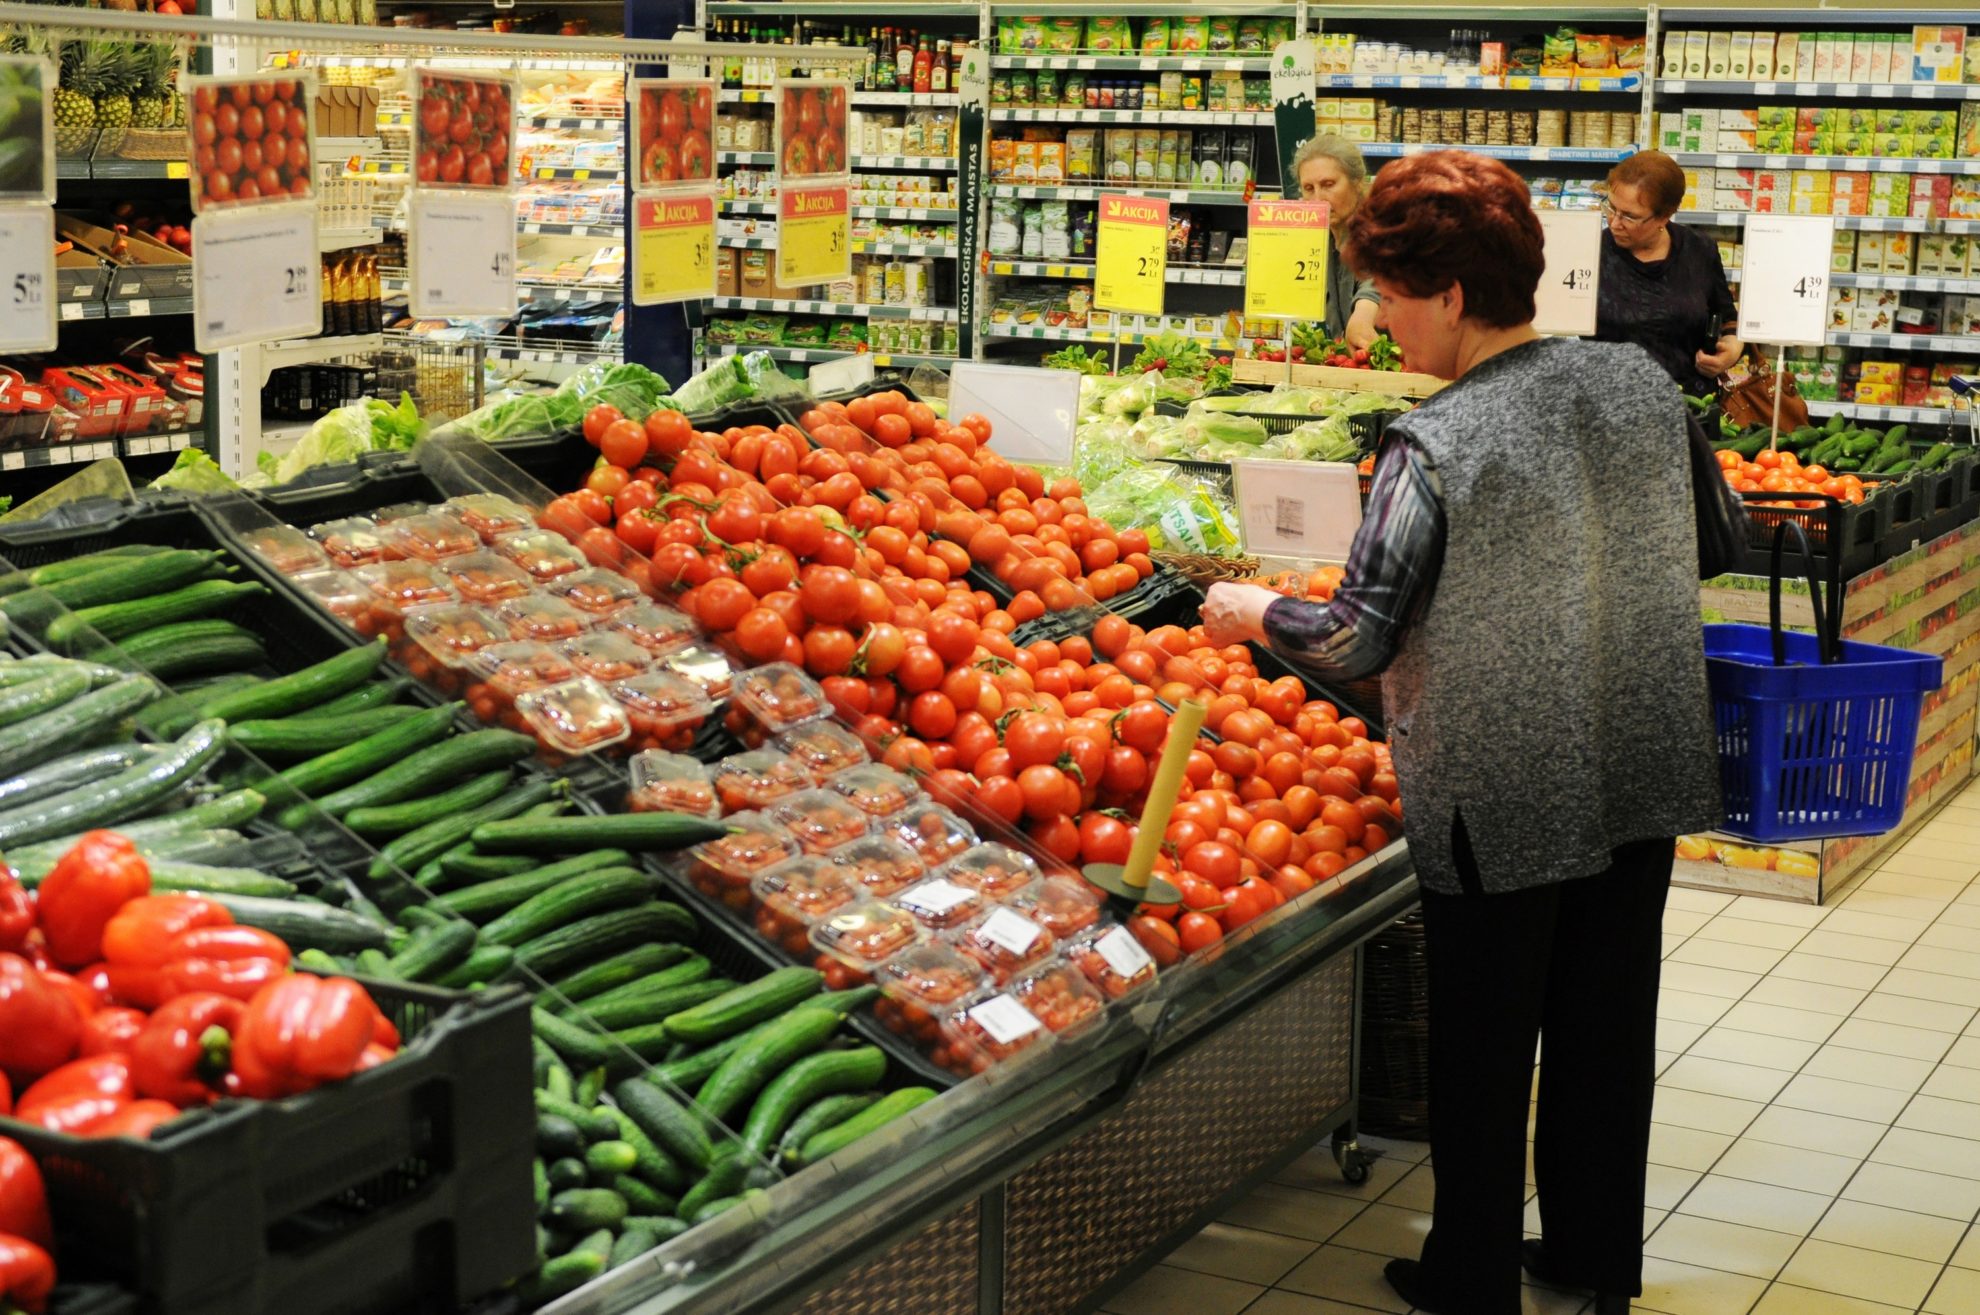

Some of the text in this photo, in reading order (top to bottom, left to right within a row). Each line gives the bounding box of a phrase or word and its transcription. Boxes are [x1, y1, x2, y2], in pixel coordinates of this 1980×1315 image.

[806, 196, 835, 212] AKCIJA
[666, 204, 699, 222] AKCIJA
[1122, 207, 1159, 222] AKCIJA
[1275, 210, 1318, 224] AKCIJA
[960, 143, 978, 325] EKOLOGIŠKAS MAISTAS
